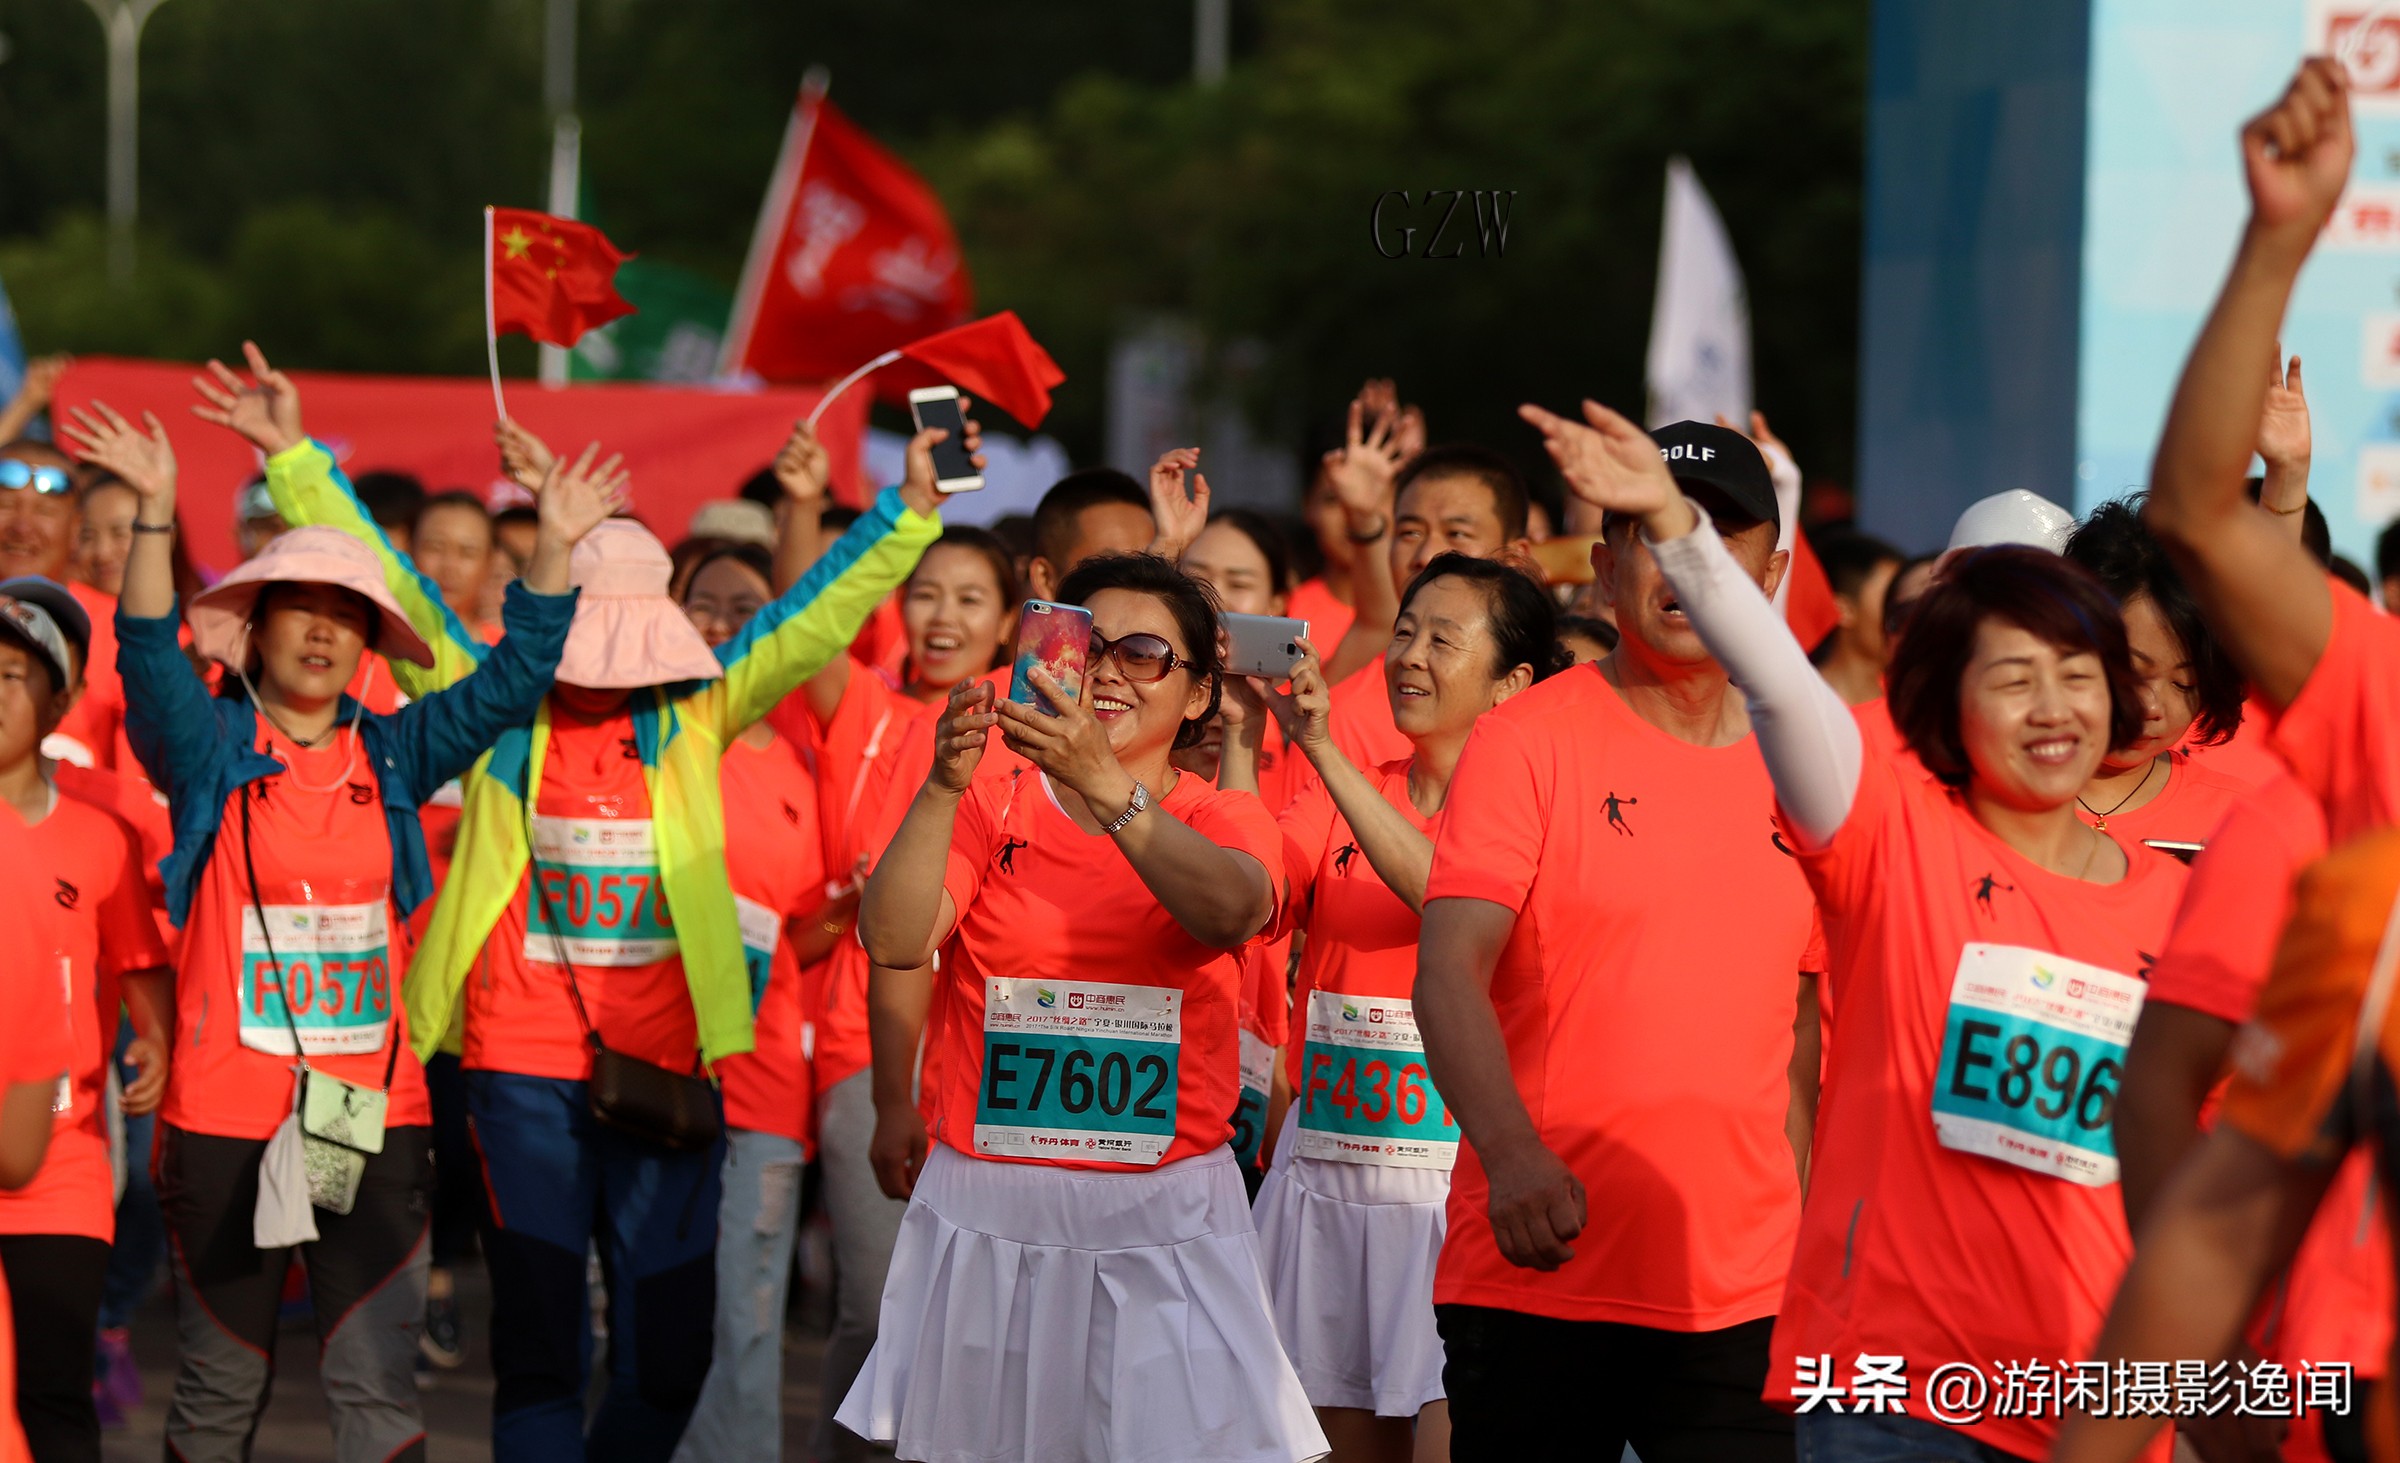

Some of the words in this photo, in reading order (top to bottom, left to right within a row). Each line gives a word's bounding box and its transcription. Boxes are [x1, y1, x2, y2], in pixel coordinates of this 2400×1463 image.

[253, 956, 386, 1016] F0579
[987, 1043, 1168, 1119] E7602
[1951, 1019, 2125, 1131] E896
